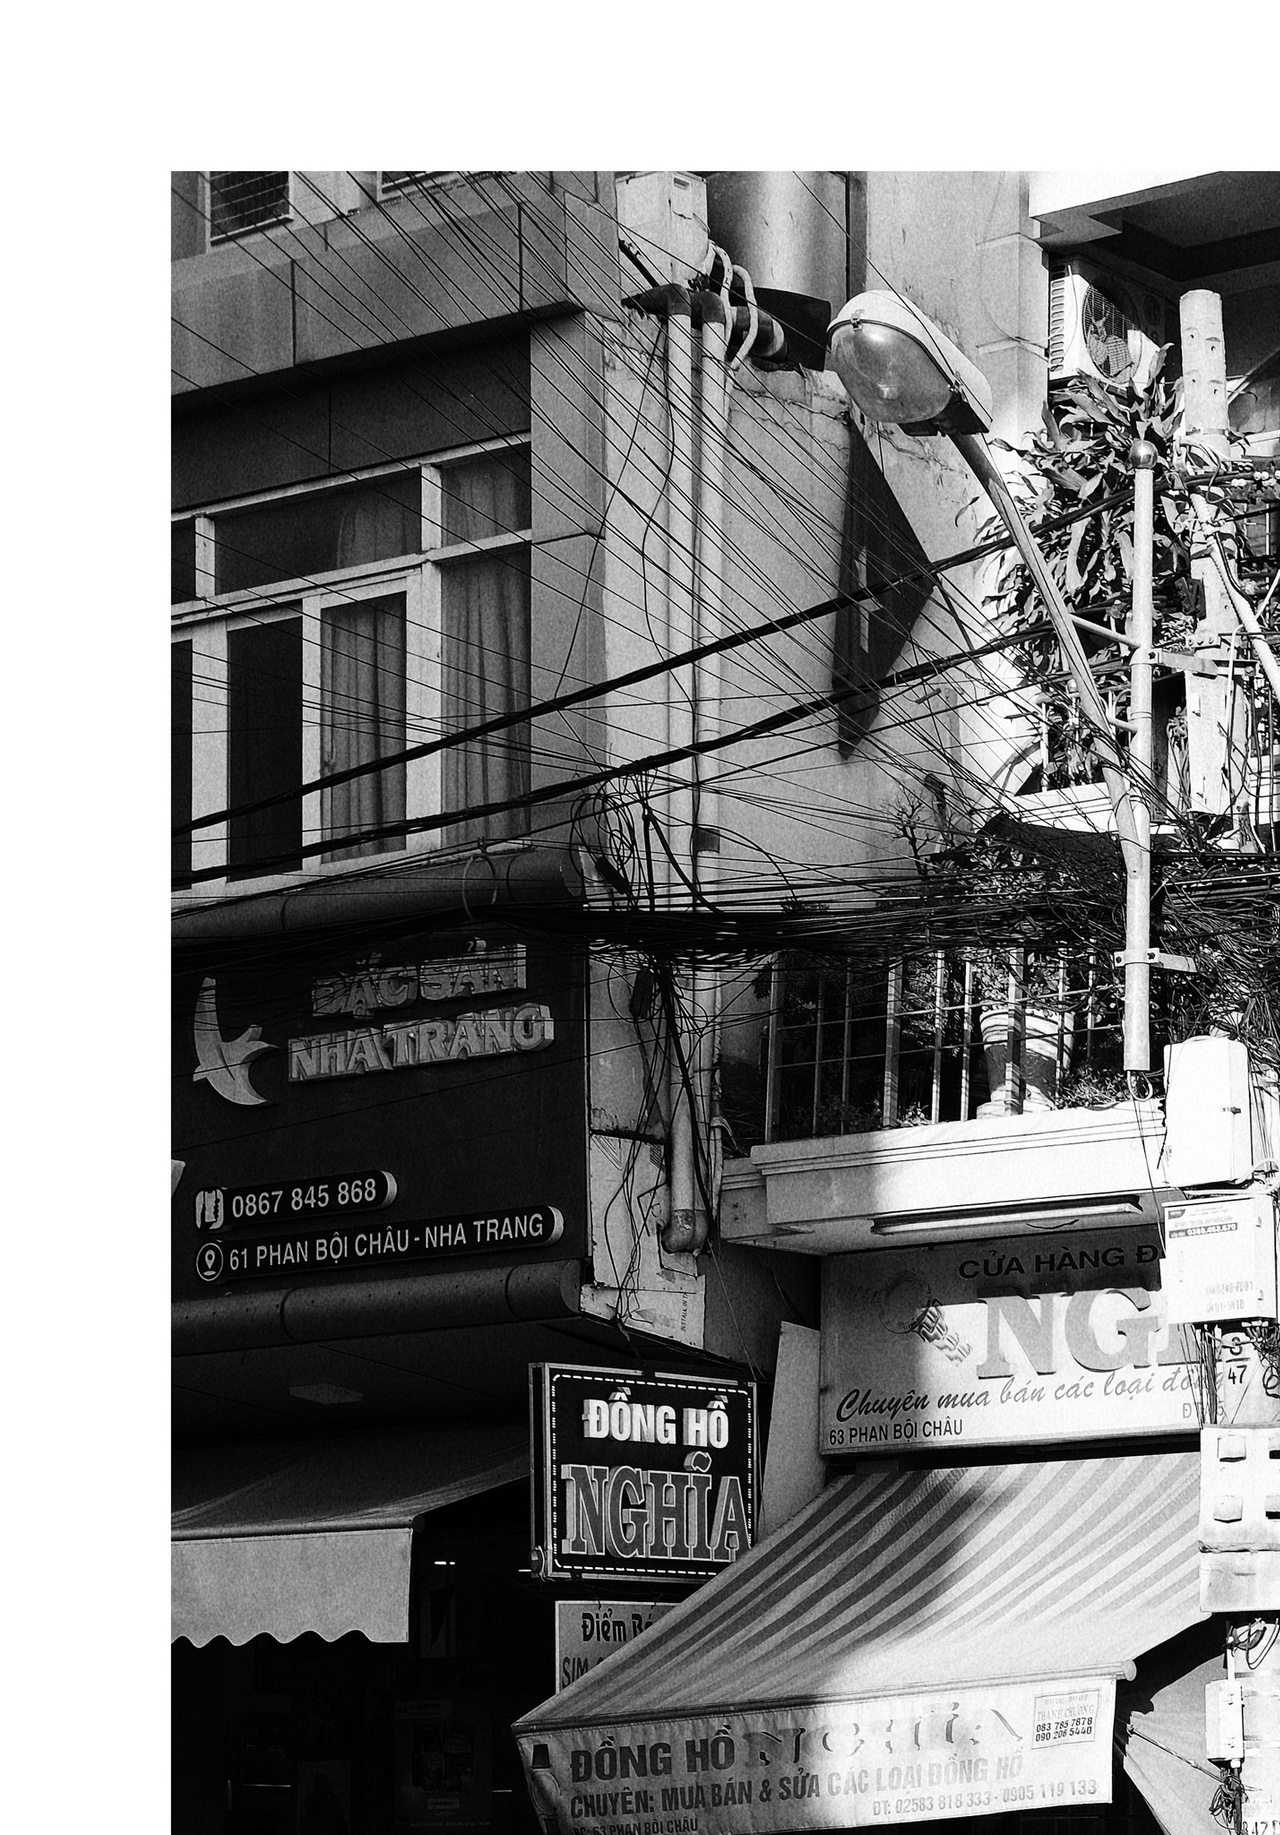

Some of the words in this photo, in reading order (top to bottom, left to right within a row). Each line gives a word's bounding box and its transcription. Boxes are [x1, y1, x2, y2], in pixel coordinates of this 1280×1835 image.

[288, 1027, 393, 1082] NHA
[383, 1002, 554, 1066] TRANG
[232, 1191, 281, 1218] 0867
[291, 1184, 329, 1211] 845
[338, 1178, 376, 1206] 868
[229, 1248, 249, 1271] 61
[256, 1241, 309, 1268] PHAN
[316, 1231, 348, 1264] BỘI
[355, 1226, 409, 1257] CHÂU
[426, 1222, 467, 1249] NHA
[473, 1213, 544, 1243] TRANG
[959, 1249, 1026, 1279] CỬA
[1035, 1247, 1125, 1273] HÀNG
[1228, 1365, 1247, 1385] 47
[836, 1388, 930, 1422] Chuyên
[937, 1391, 991, 1409] mua
[999, 1375, 1046, 1404] bán
[1054, 1376, 1095, 1400] các
[1103, 1371, 1154, 1405] loại
[582, 1387, 676, 1444] ĐỒNG
[683, 1395, 729, 1448] HỒ
[829, 1430, 845, 1445] 63
[849, 1424, 889, 1444] PHAN
[893, 1418, 918, 1443] BỘI
[922, 1415, 963, 1438] CHÂU
[561, 1451, 752, 1562] NGHĨA
[582, 1606, 626, 1642] Điểm
[1035, 1732, 1051, 1742] 090
[1069, 1726, 1092, 1736] 5440
[1036, 1722, 1051, 1732] 083
[1071, 1717, 1093, 1727] 7878
[570, 1736, 672, 1783] ĐỒNG
[685, 1725, 735, 1773] HỒ
[571, 1786, 655, 1818] CHUYÊN:
[661, 1785, 706, 1812] MUA
[712, 1777, 752, 1807] BÁN
[758, 1779, 772, 1802] &
[778, 1767, 820, 1800] SỬA
[827, 1764, 869, 1796] CÁC
[876, 1764, 922, 1795] LOẠI
[928, 1753, 988, 1785] ĐỒNG
[996, 1746, 1024, 1780] HỒ
[873, 1801, 891, 1816] ĐT:
[896, 1797, 933, 1814] 02583
[966, 1791, 991, 1807] 333
[1003, 1784, 1034, 1804] 0905
[667, 1817, 698, 1834] CHÂU
